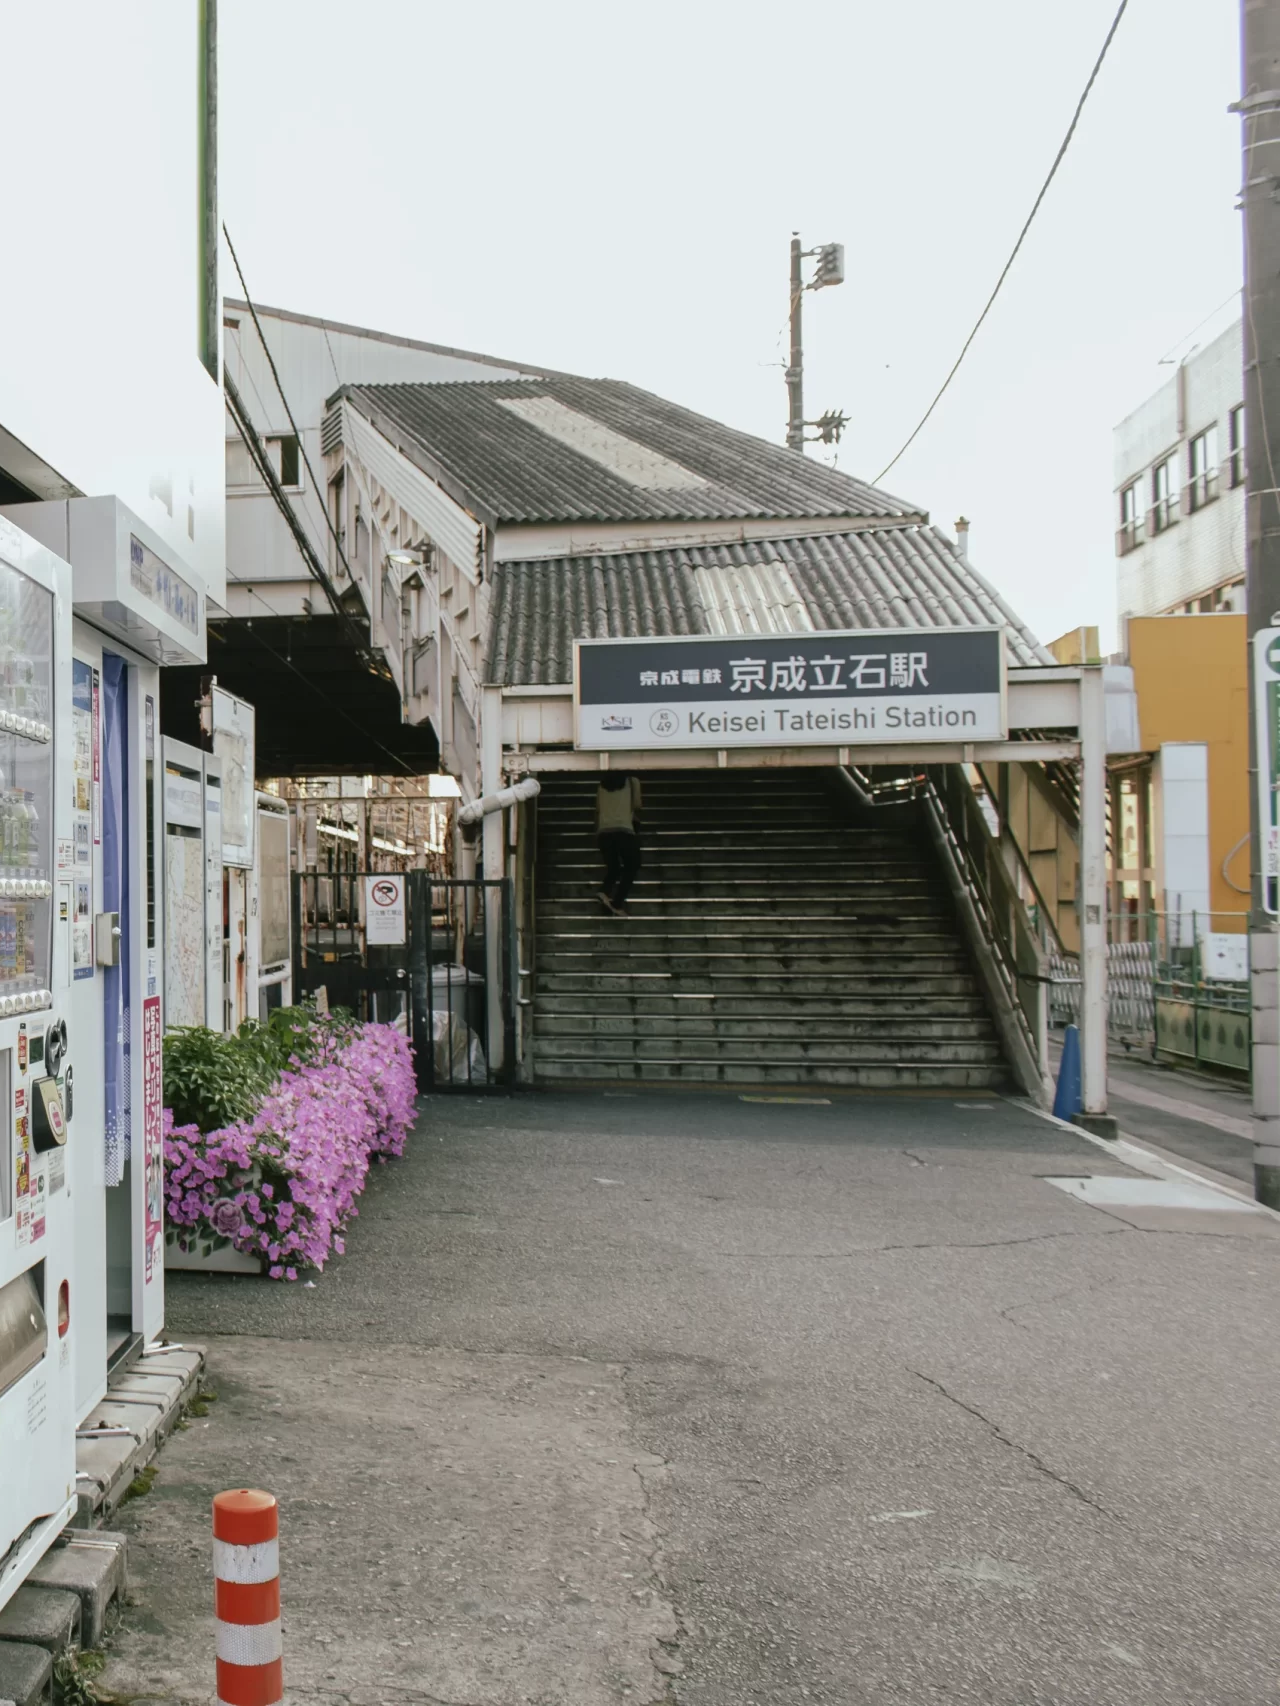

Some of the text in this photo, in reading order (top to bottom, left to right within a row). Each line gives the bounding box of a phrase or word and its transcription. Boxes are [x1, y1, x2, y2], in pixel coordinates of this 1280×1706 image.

[639, 651, 930, 694] 京成電鉄 京成立石駅
[656, 721, 672, 732] 49
[688, 706, 977, 734] Keisei Tateishi Station
